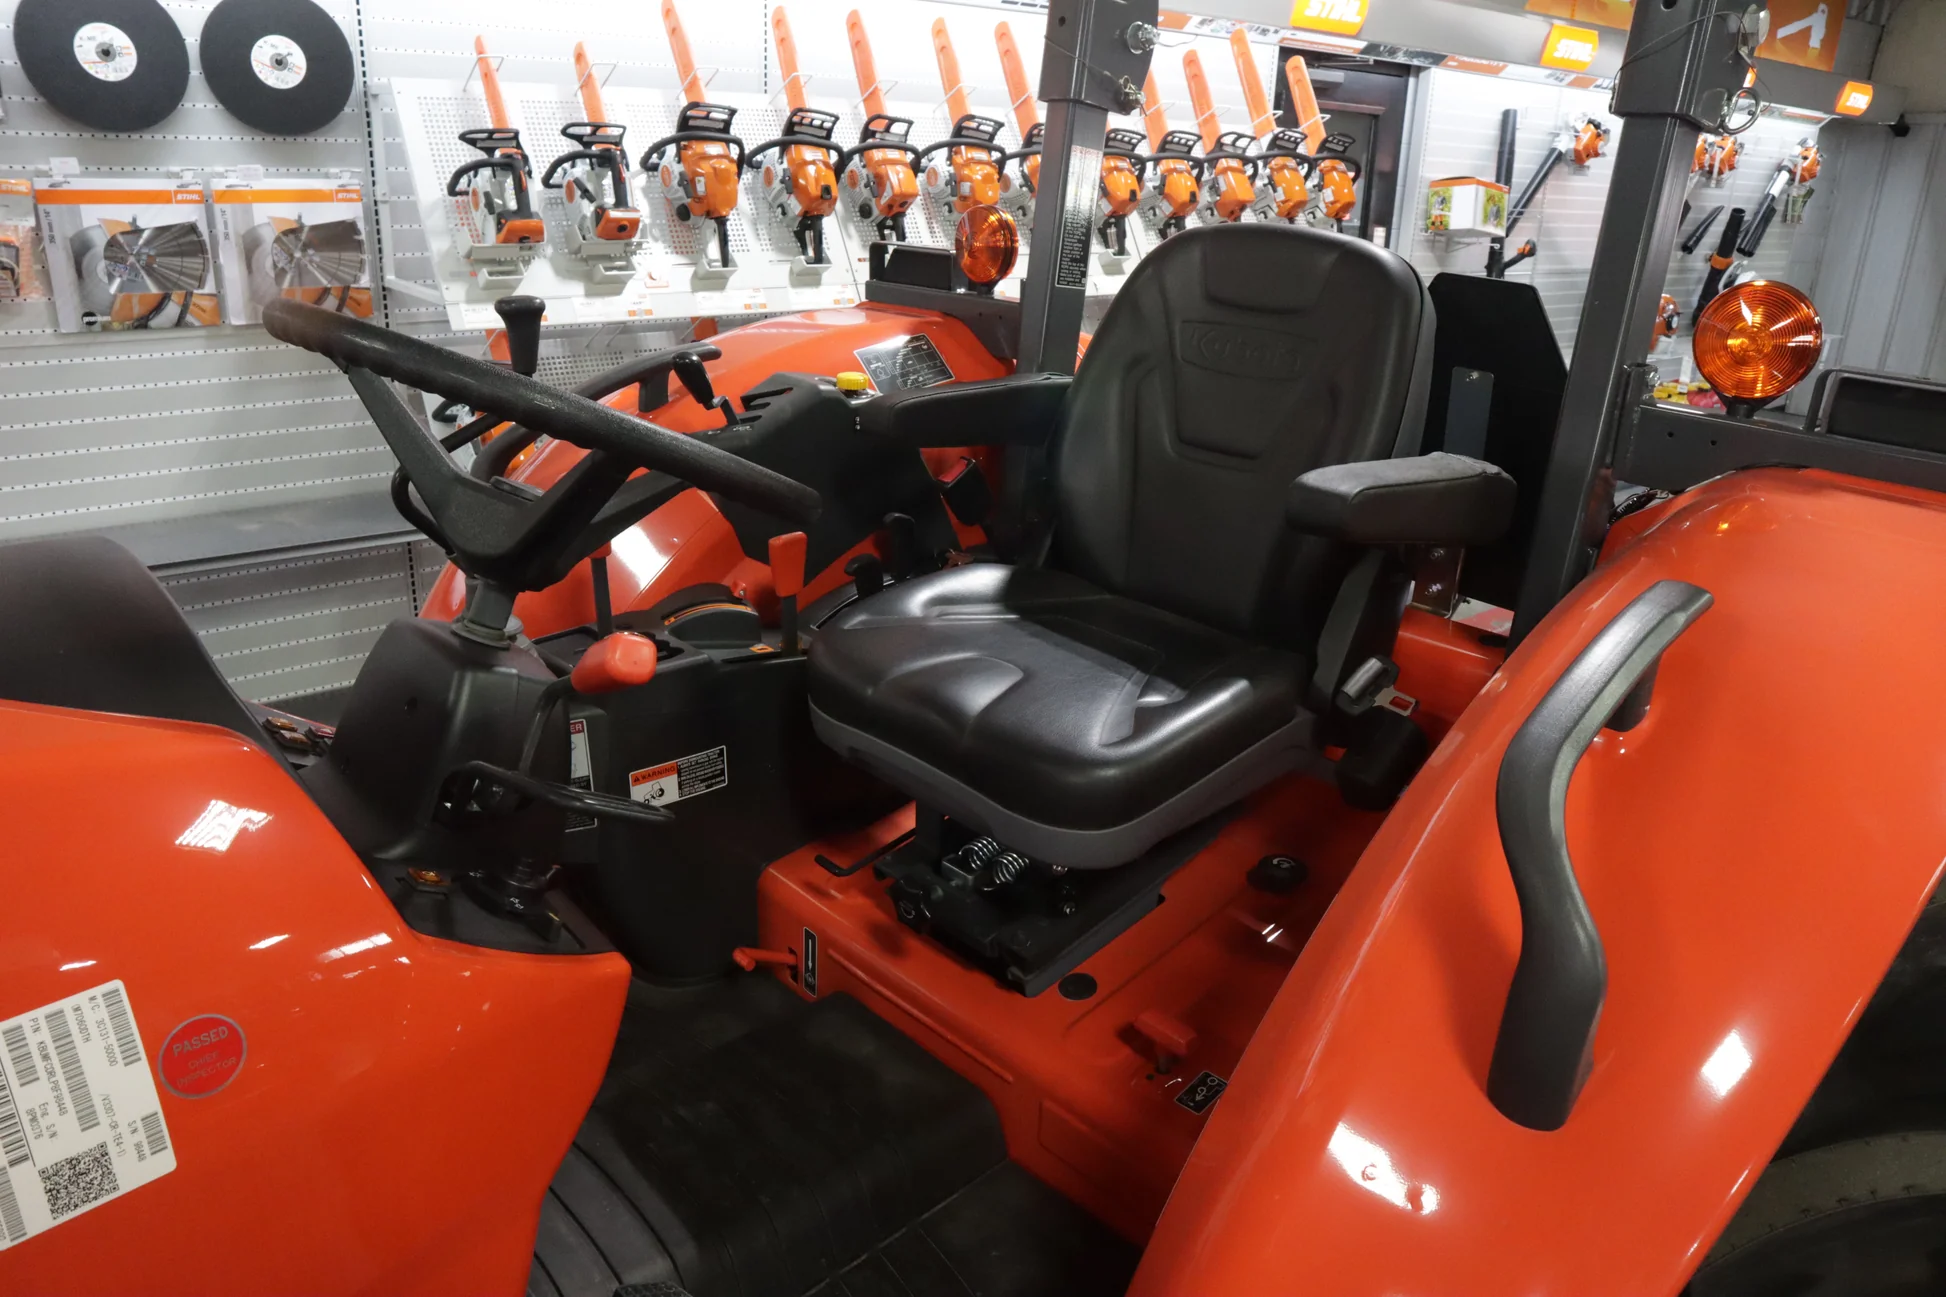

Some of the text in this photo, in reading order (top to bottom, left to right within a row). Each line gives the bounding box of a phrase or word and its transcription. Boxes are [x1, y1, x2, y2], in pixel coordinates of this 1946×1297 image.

[176, 193, 201, 201] STIHL
[337, 192, 359, 200] STIHL
[641, 766, 675, 780] WARNING
[88, 995, 118, 1067] M/C: 3C131-50000
[172, 1026, 228, 1056] PASSED
[188, 1051, 219, 1070] CHIEF
[177, 1057, 237, 1087] INSPECTOR
[38, 1102, 50, 1120] Eng.
